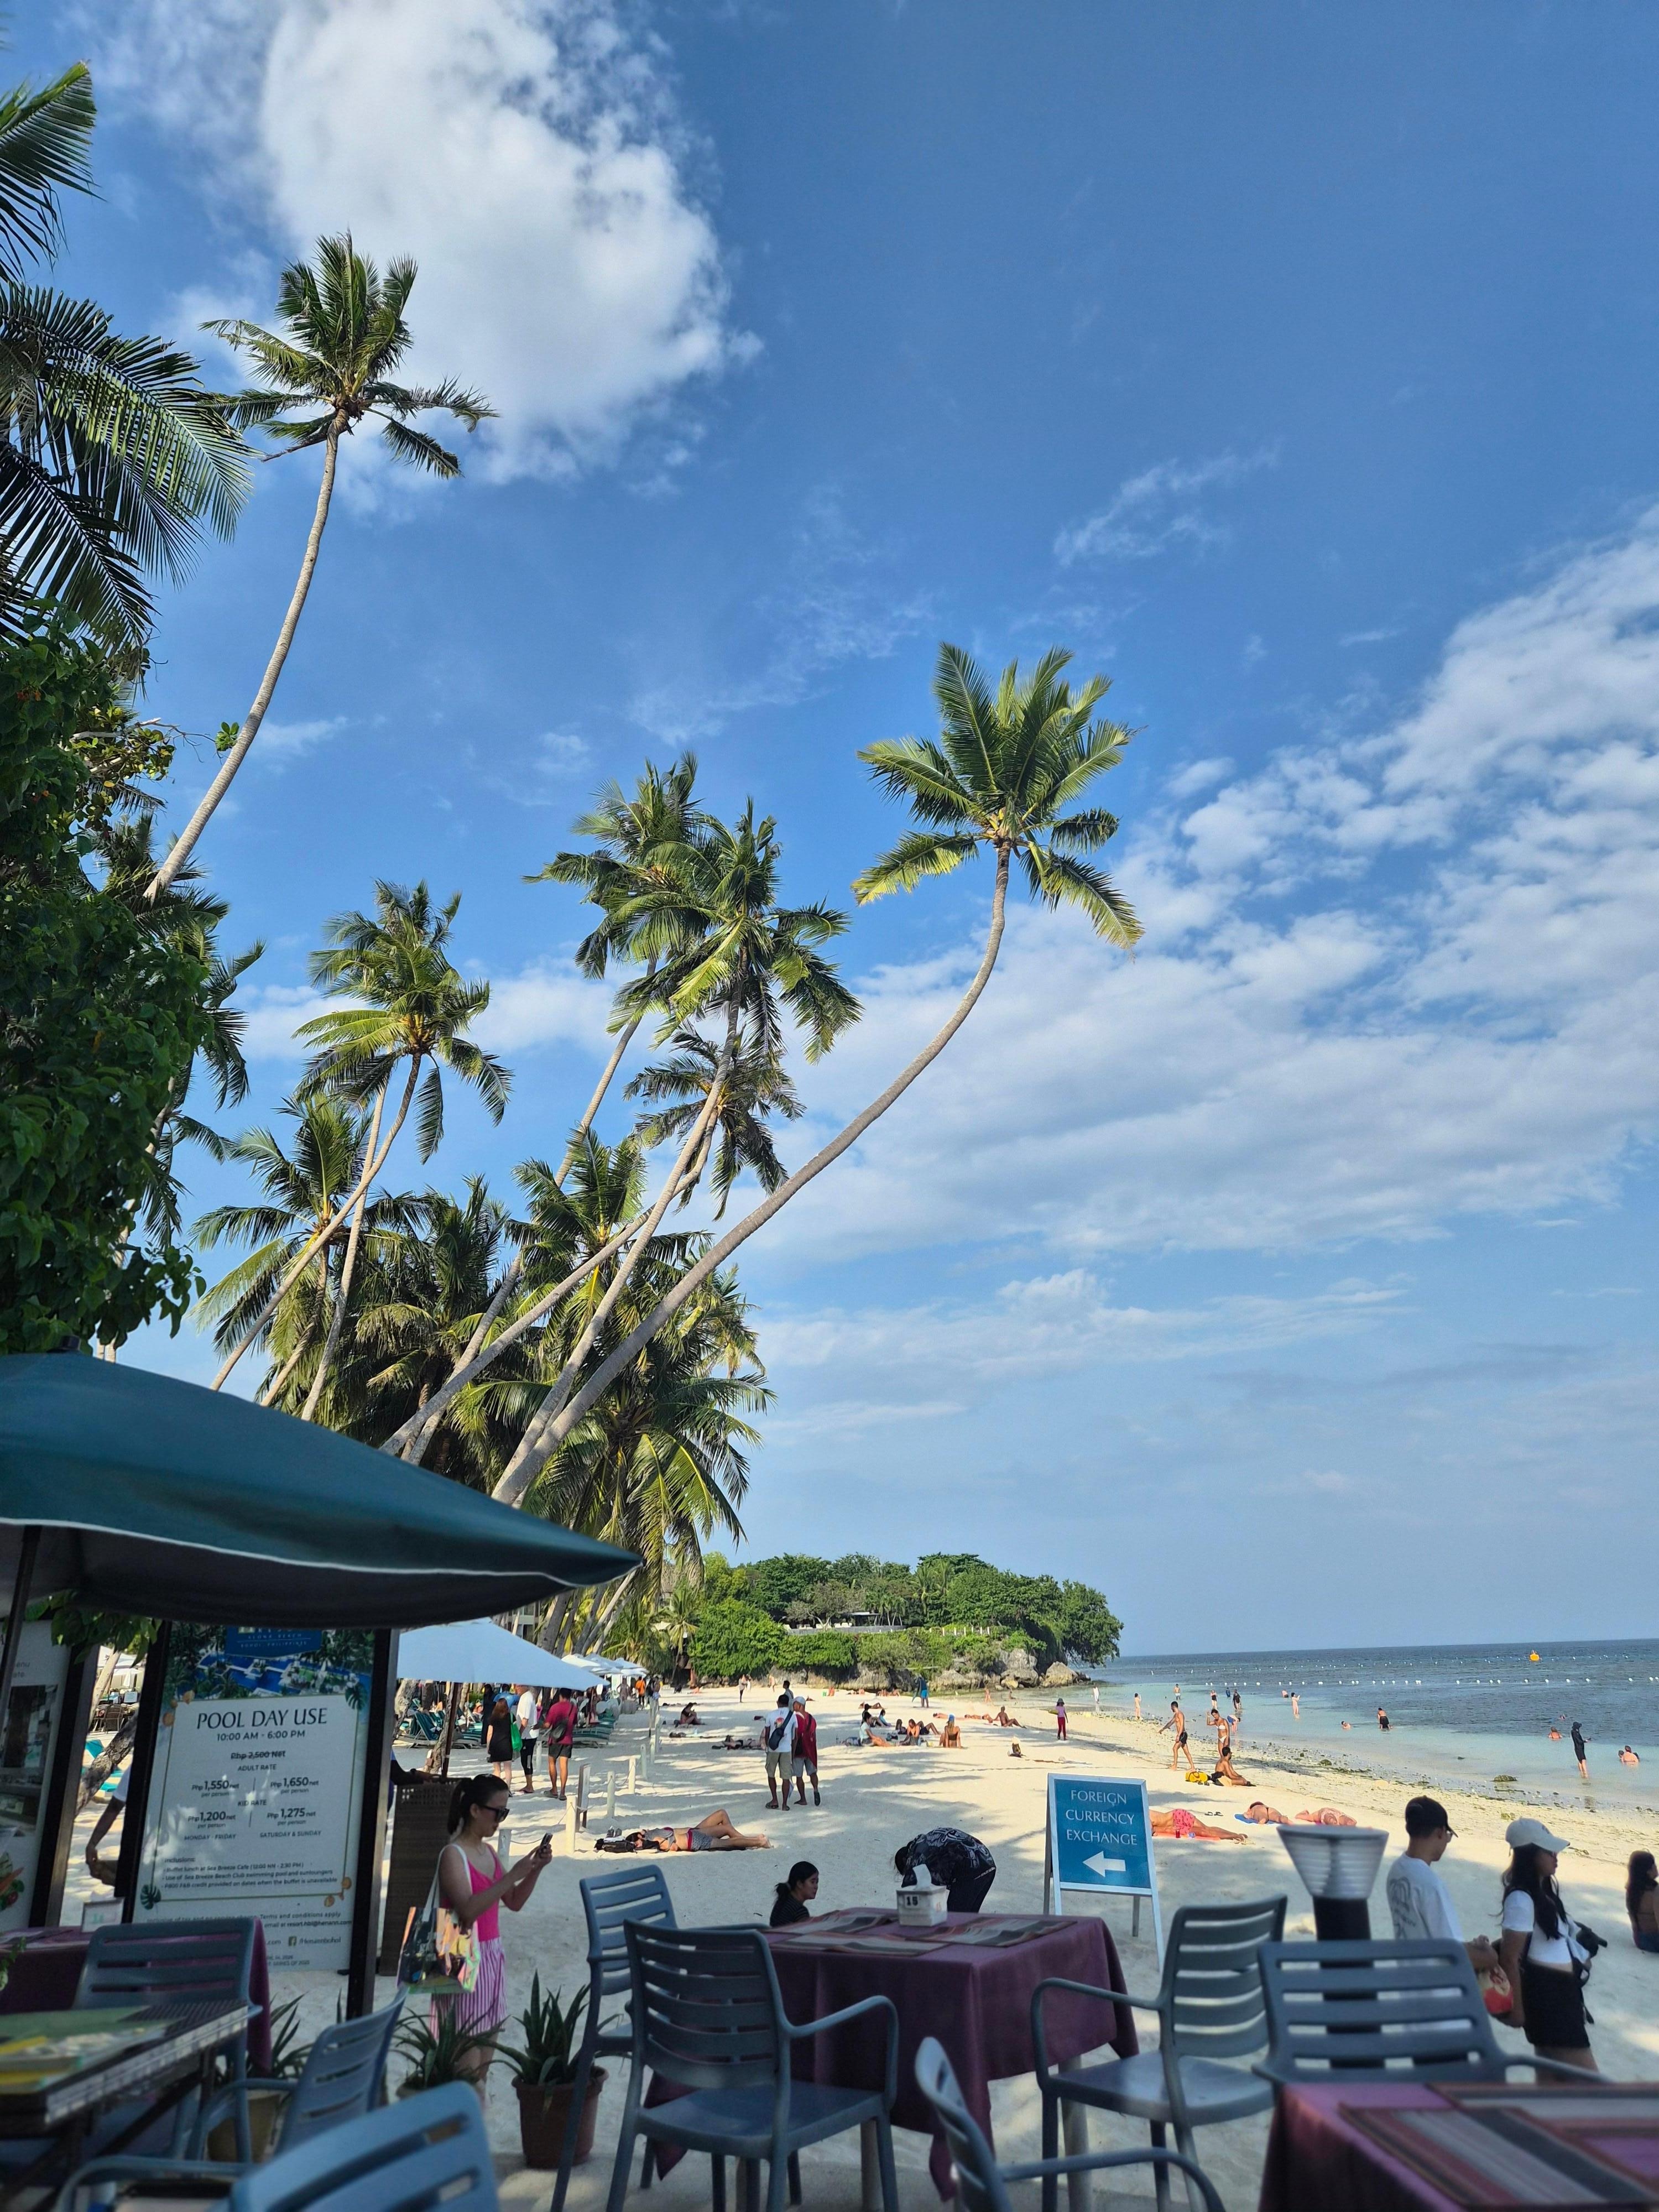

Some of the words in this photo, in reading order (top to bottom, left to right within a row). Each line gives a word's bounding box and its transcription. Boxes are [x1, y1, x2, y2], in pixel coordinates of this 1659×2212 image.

[197, 1712, 244, 1729] POOL
[252, 1709, 288, 1727] DAY
[294, 1708, 327, 1725] USE
[217, 1733, 241, 1741] 10:00
[267, 1730, 288, 1739] 6:00
[204, 1780, 229, 1791] 1,550
[283, 1777, 309, 1788] 1,650
[1071, 1790, 1126, 1805] FOREIGN
[200, 1811, 226, 1822] 1,200
[280, 1808, 305, 1818] 1,275
[1066, 1809, 1134, 1825] CURRENCY
[1066, 1829, 1138, 1845] EXCHANGE
[906, 1896, 918, 1906] 15
